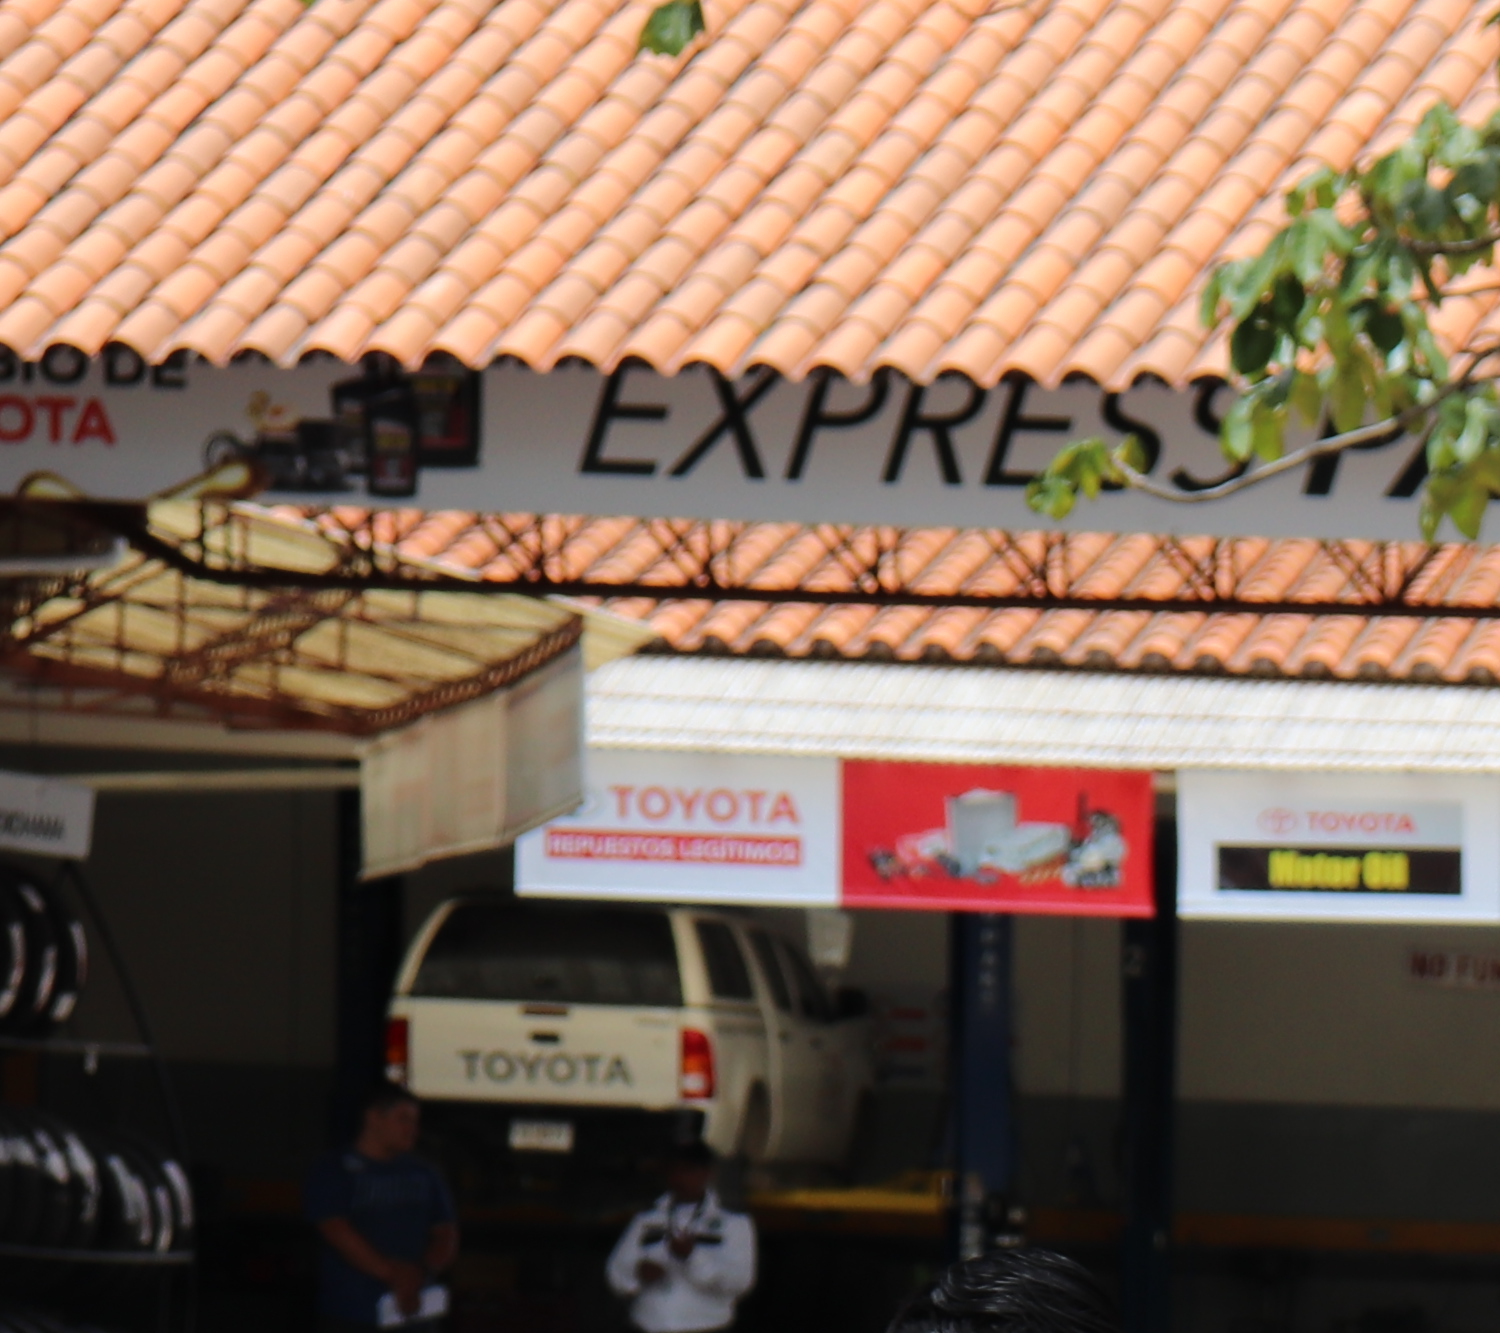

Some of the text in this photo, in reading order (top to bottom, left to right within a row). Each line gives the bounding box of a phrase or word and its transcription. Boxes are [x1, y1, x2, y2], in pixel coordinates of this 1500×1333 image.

[577, 360, 1258, 500] EXPRESS
[608, 784, 800, 825] TOYOTA
[1306, 810, 1417, 833] TOYOTA
[549, 833, 672, 858] REPUESTOS
[1267, 850, 1361, 889] Motor
[459, 1050, 635, 1086] TOYOTA
